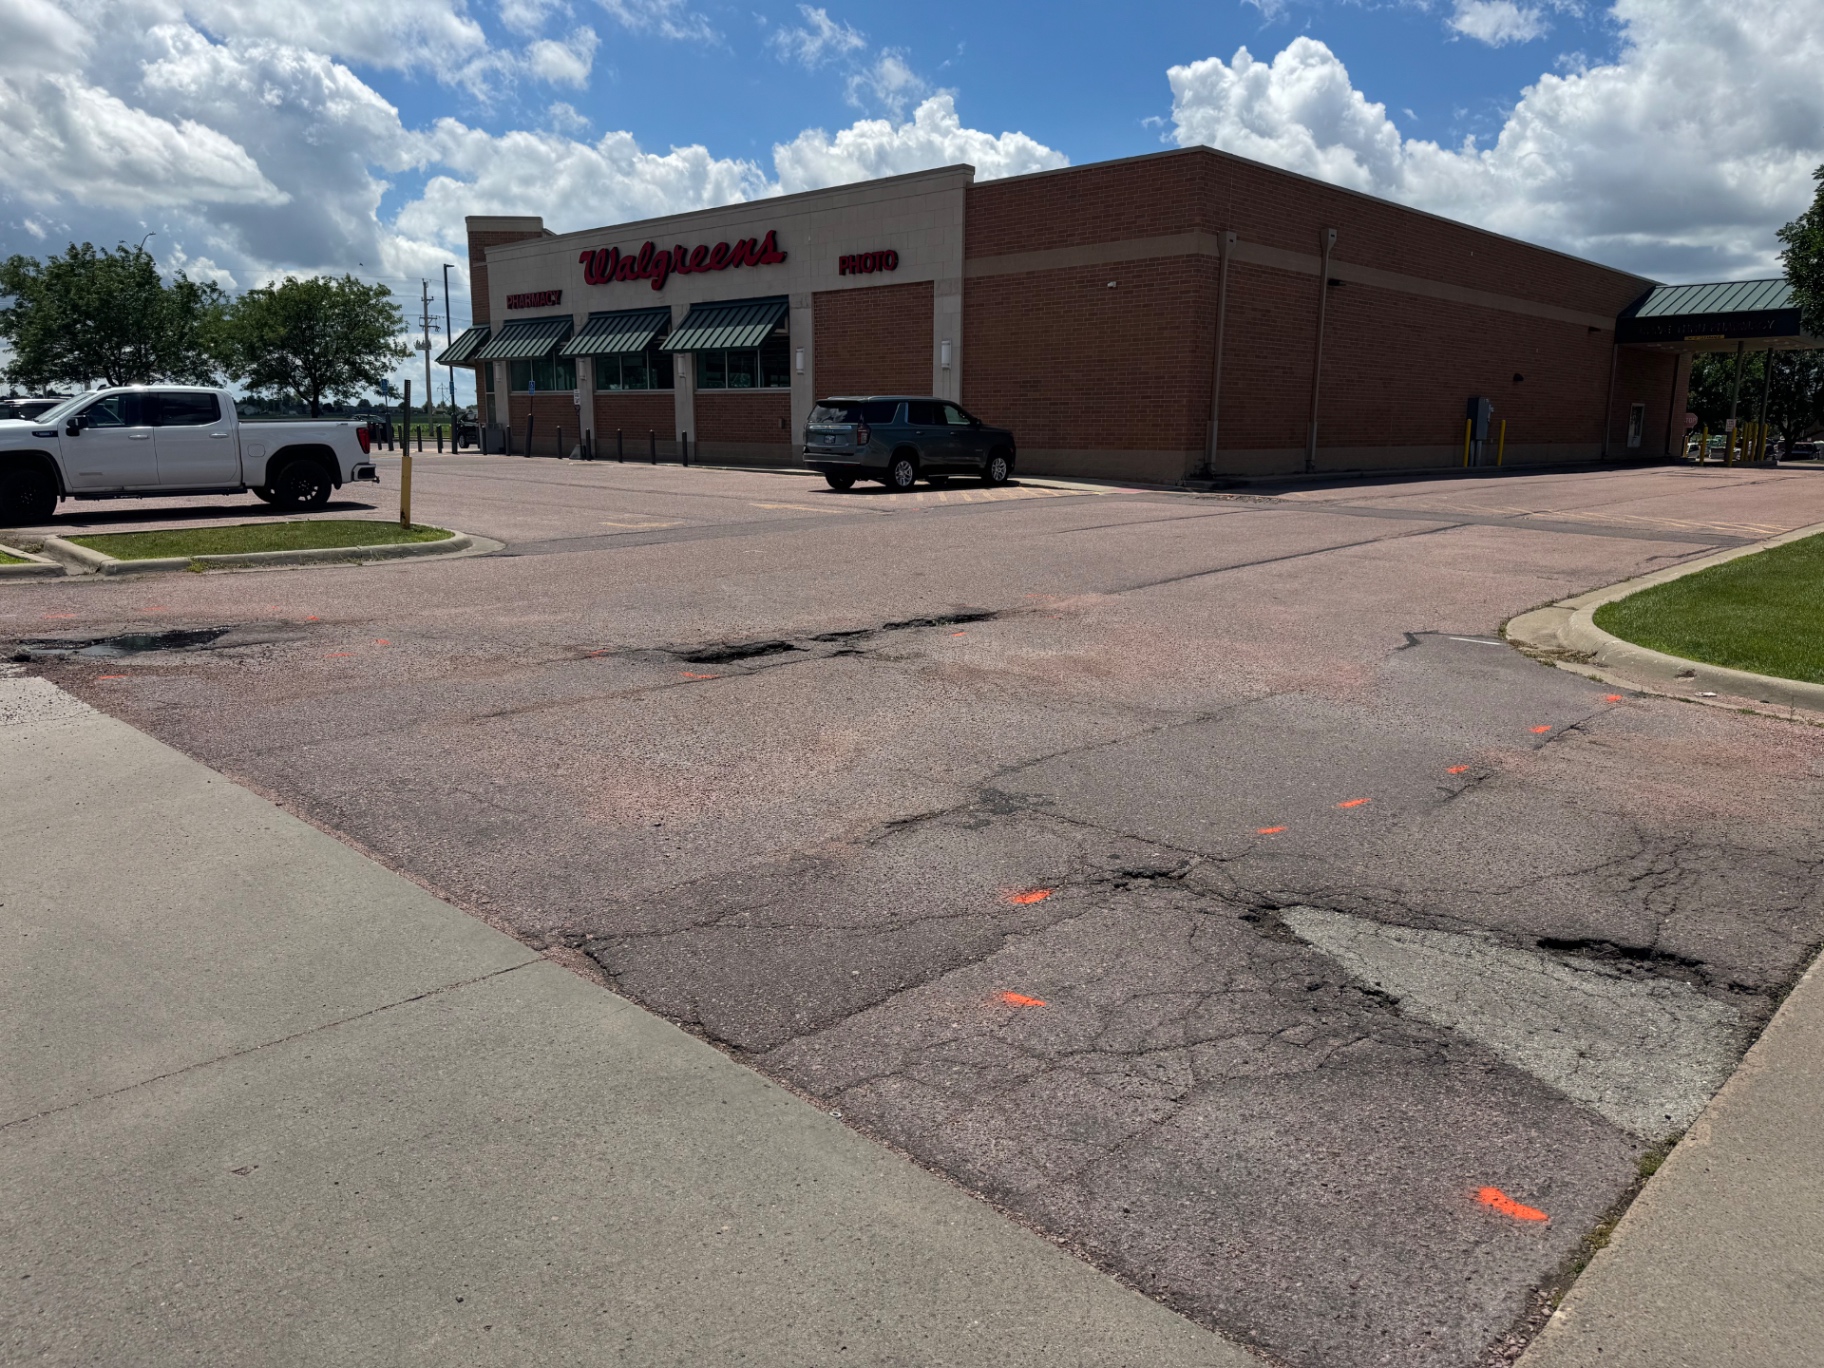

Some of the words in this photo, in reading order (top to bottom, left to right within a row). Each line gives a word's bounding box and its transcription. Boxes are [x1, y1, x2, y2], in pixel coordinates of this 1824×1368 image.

[579, 230, 786, 290] Walgreens
[839, 250, 898, 275] PHOTO
[506, 290, 562, 309] PHARMACY
